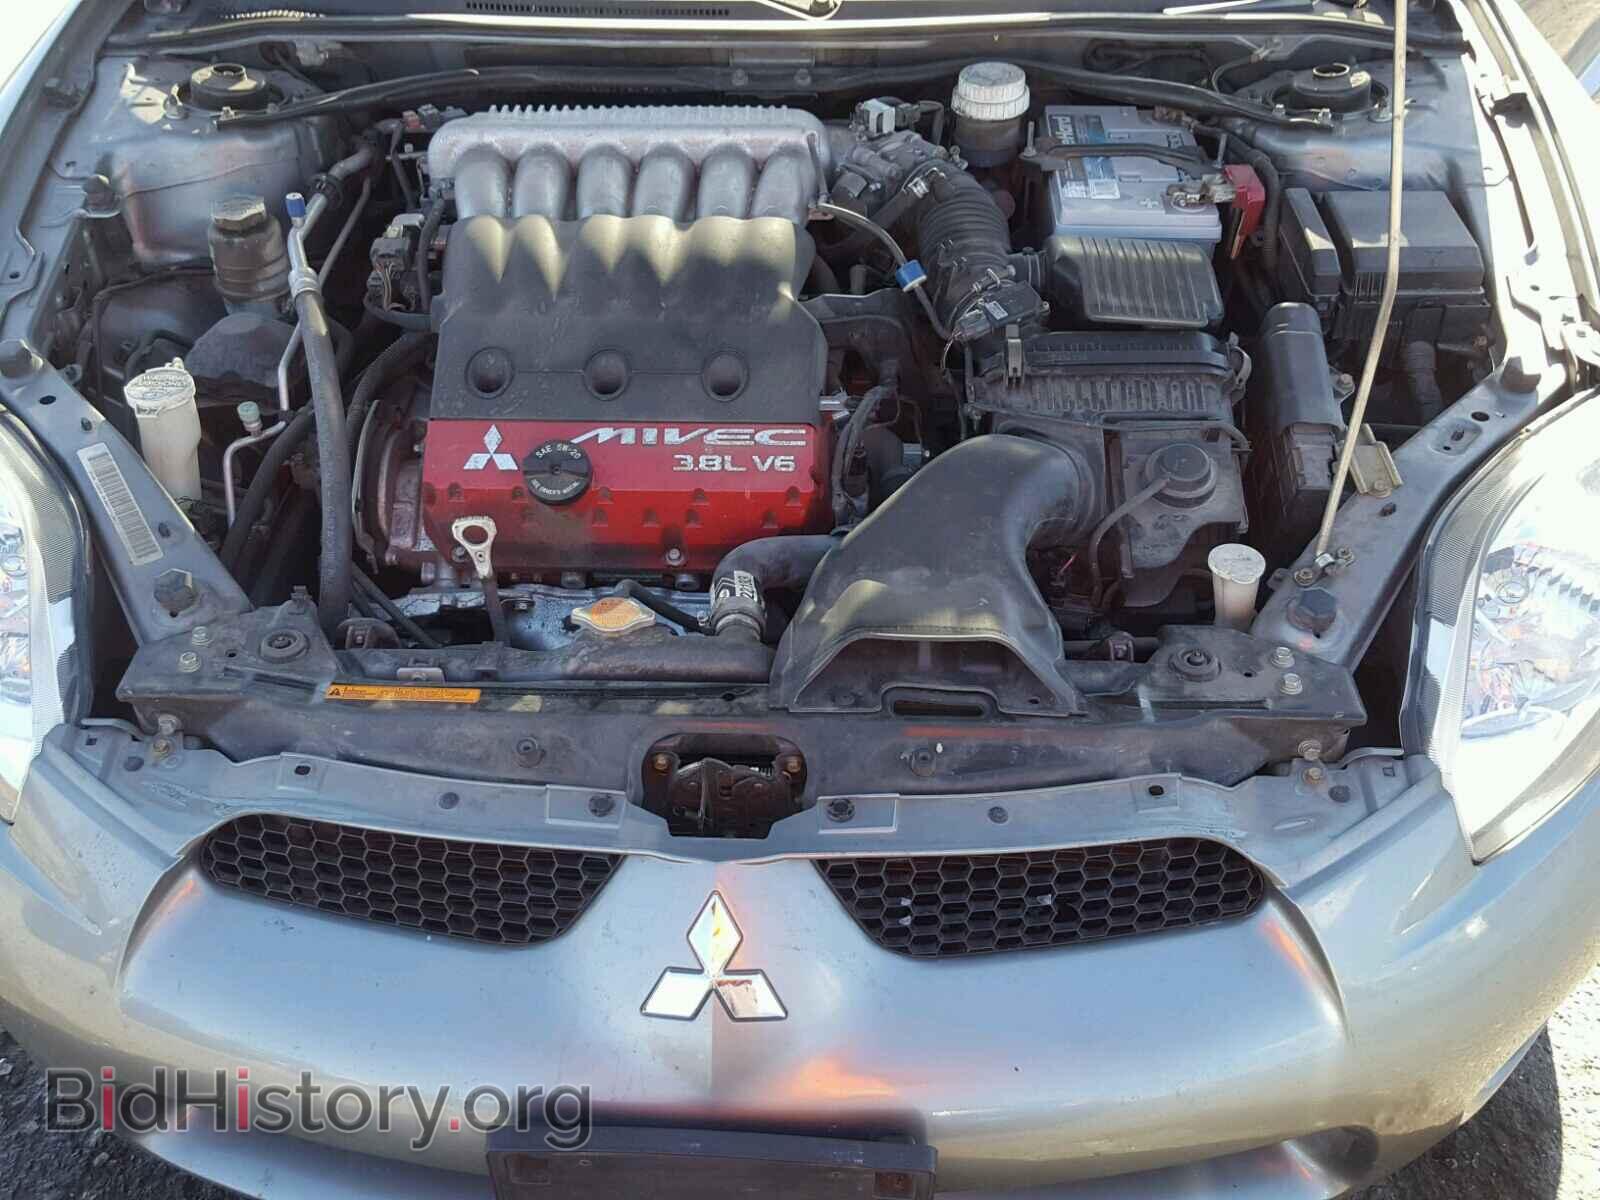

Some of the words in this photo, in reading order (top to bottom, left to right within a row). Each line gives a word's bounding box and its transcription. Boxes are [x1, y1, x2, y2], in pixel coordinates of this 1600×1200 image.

[570, 427, 806, 446] MIVEC
[535, 444, 553, 458] SAE
[672, 454, 747, 472] 3.8L
[752, 455, 796, 472] V6
